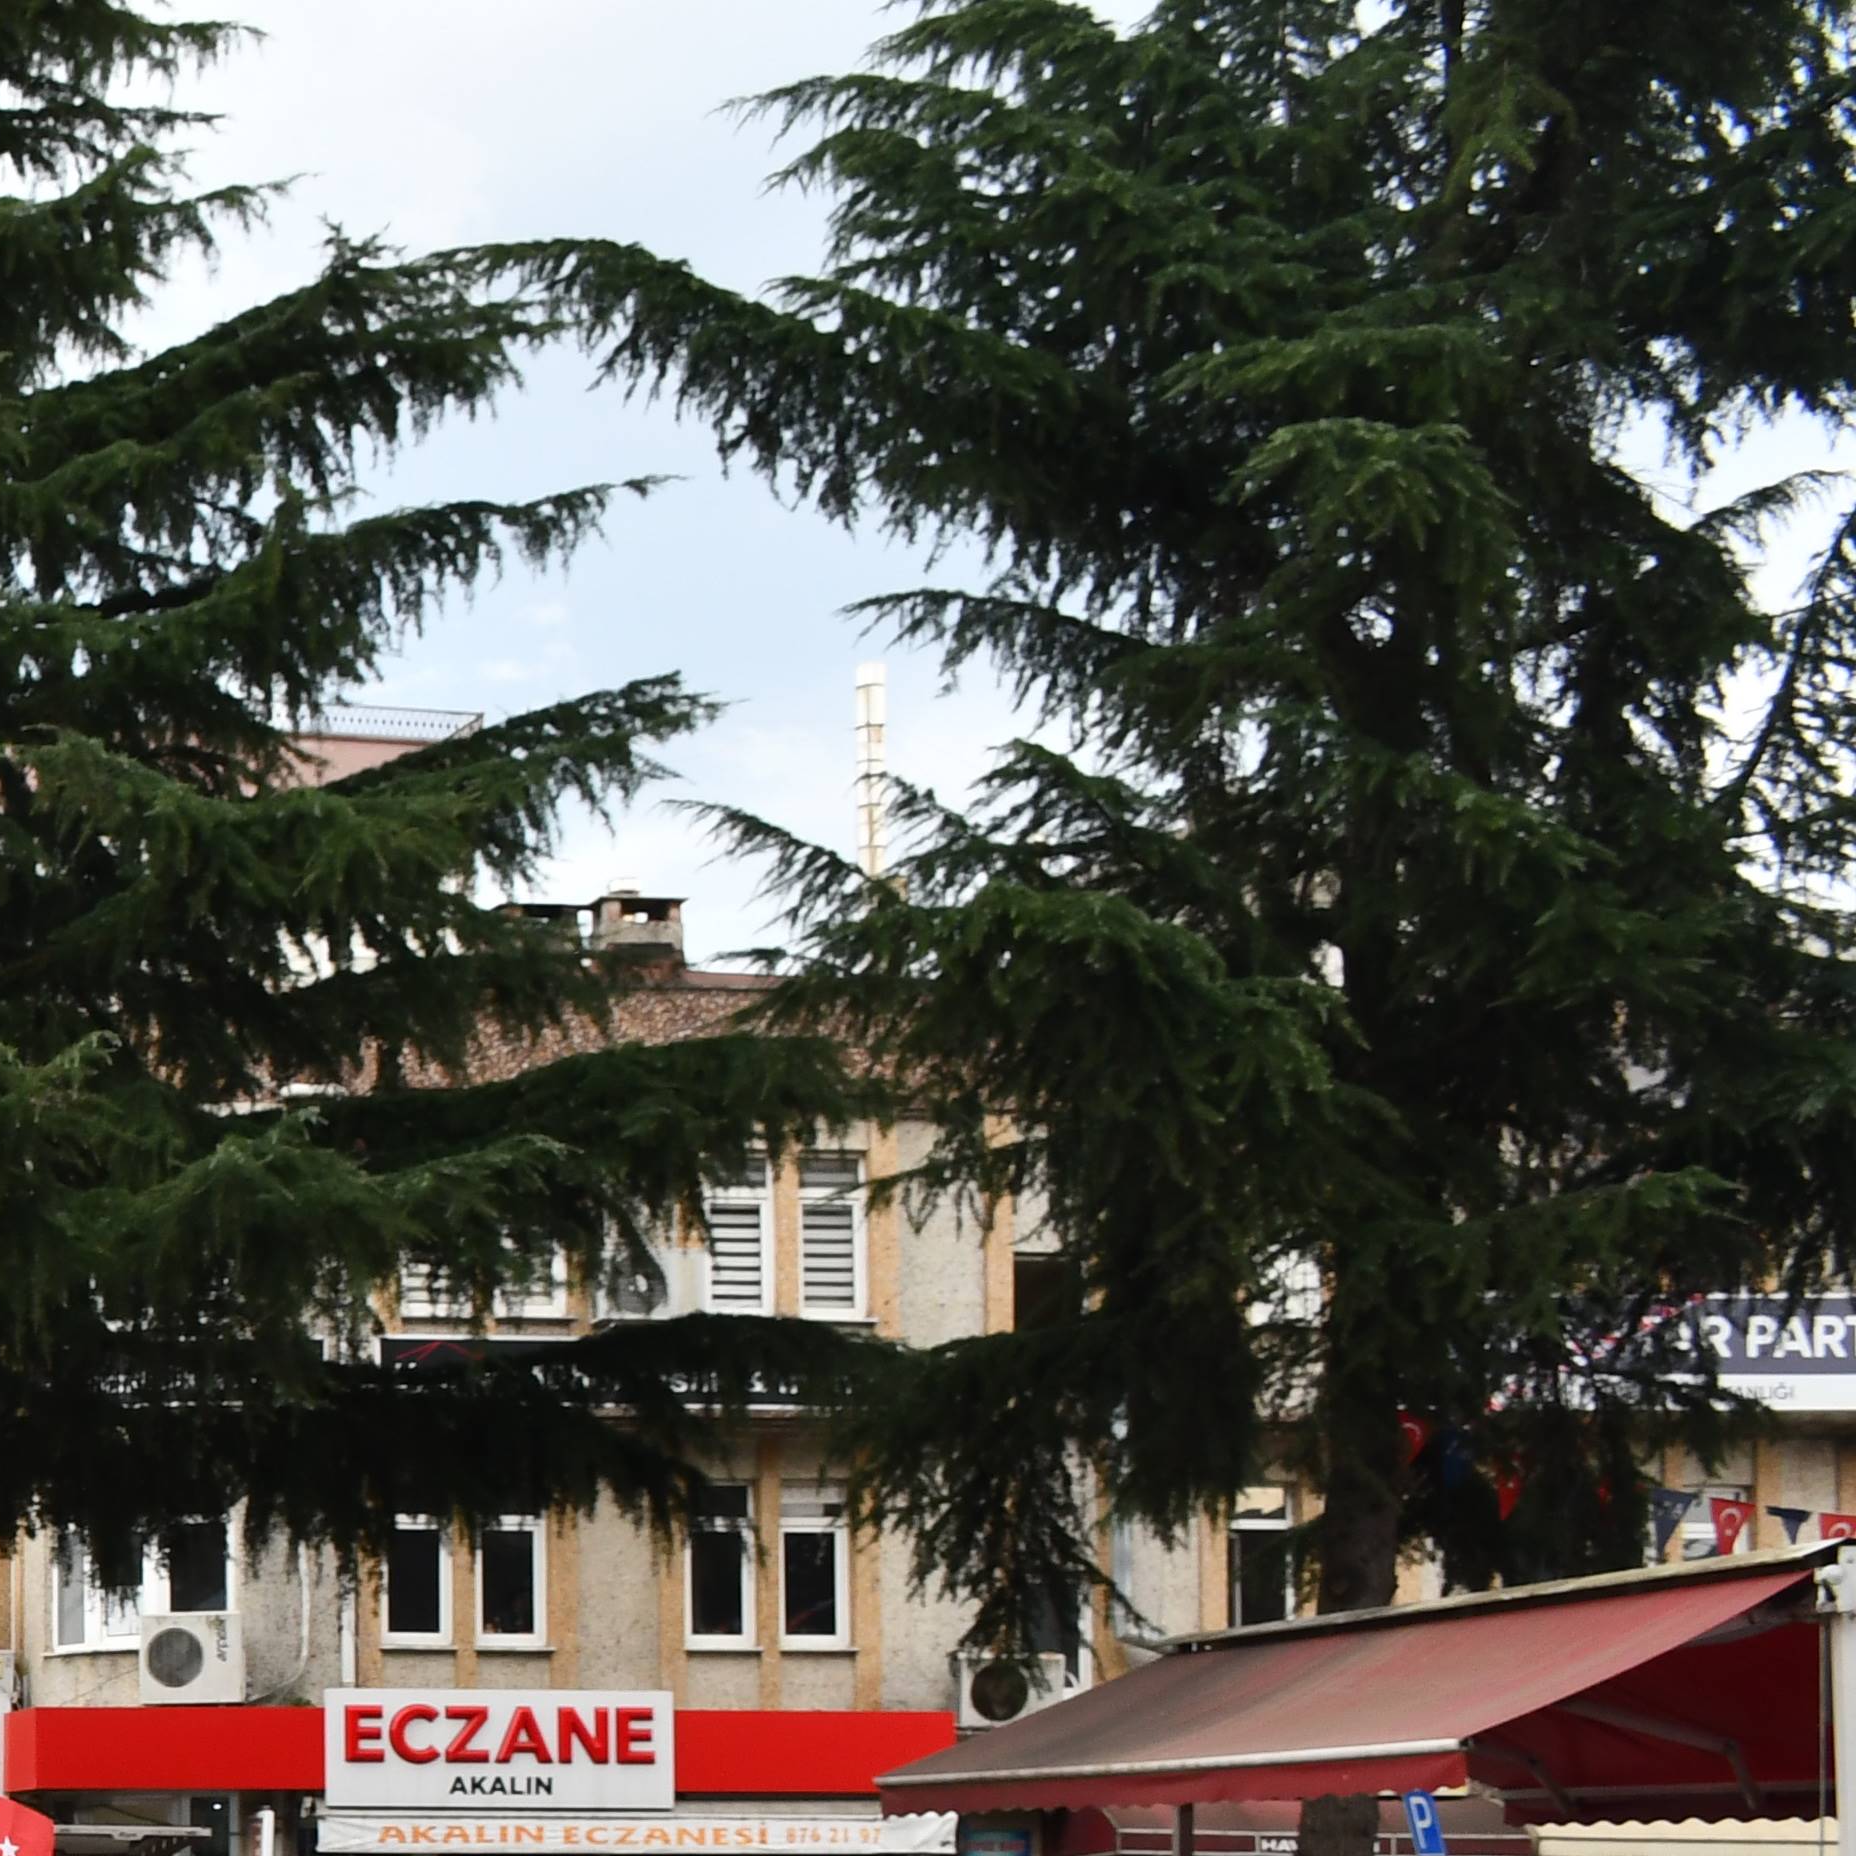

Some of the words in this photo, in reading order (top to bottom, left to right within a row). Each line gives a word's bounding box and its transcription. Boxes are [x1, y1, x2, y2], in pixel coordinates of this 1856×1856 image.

[344, 1703, 657, 1765] ECZANE
[449, 1776, 554, 1796] AKALIN
[378, 1824, 545, 1846] AKALIN
[562, 1821, 768, 1847] ECZANESİ
[1408, 1795, 1433, 1850] P
